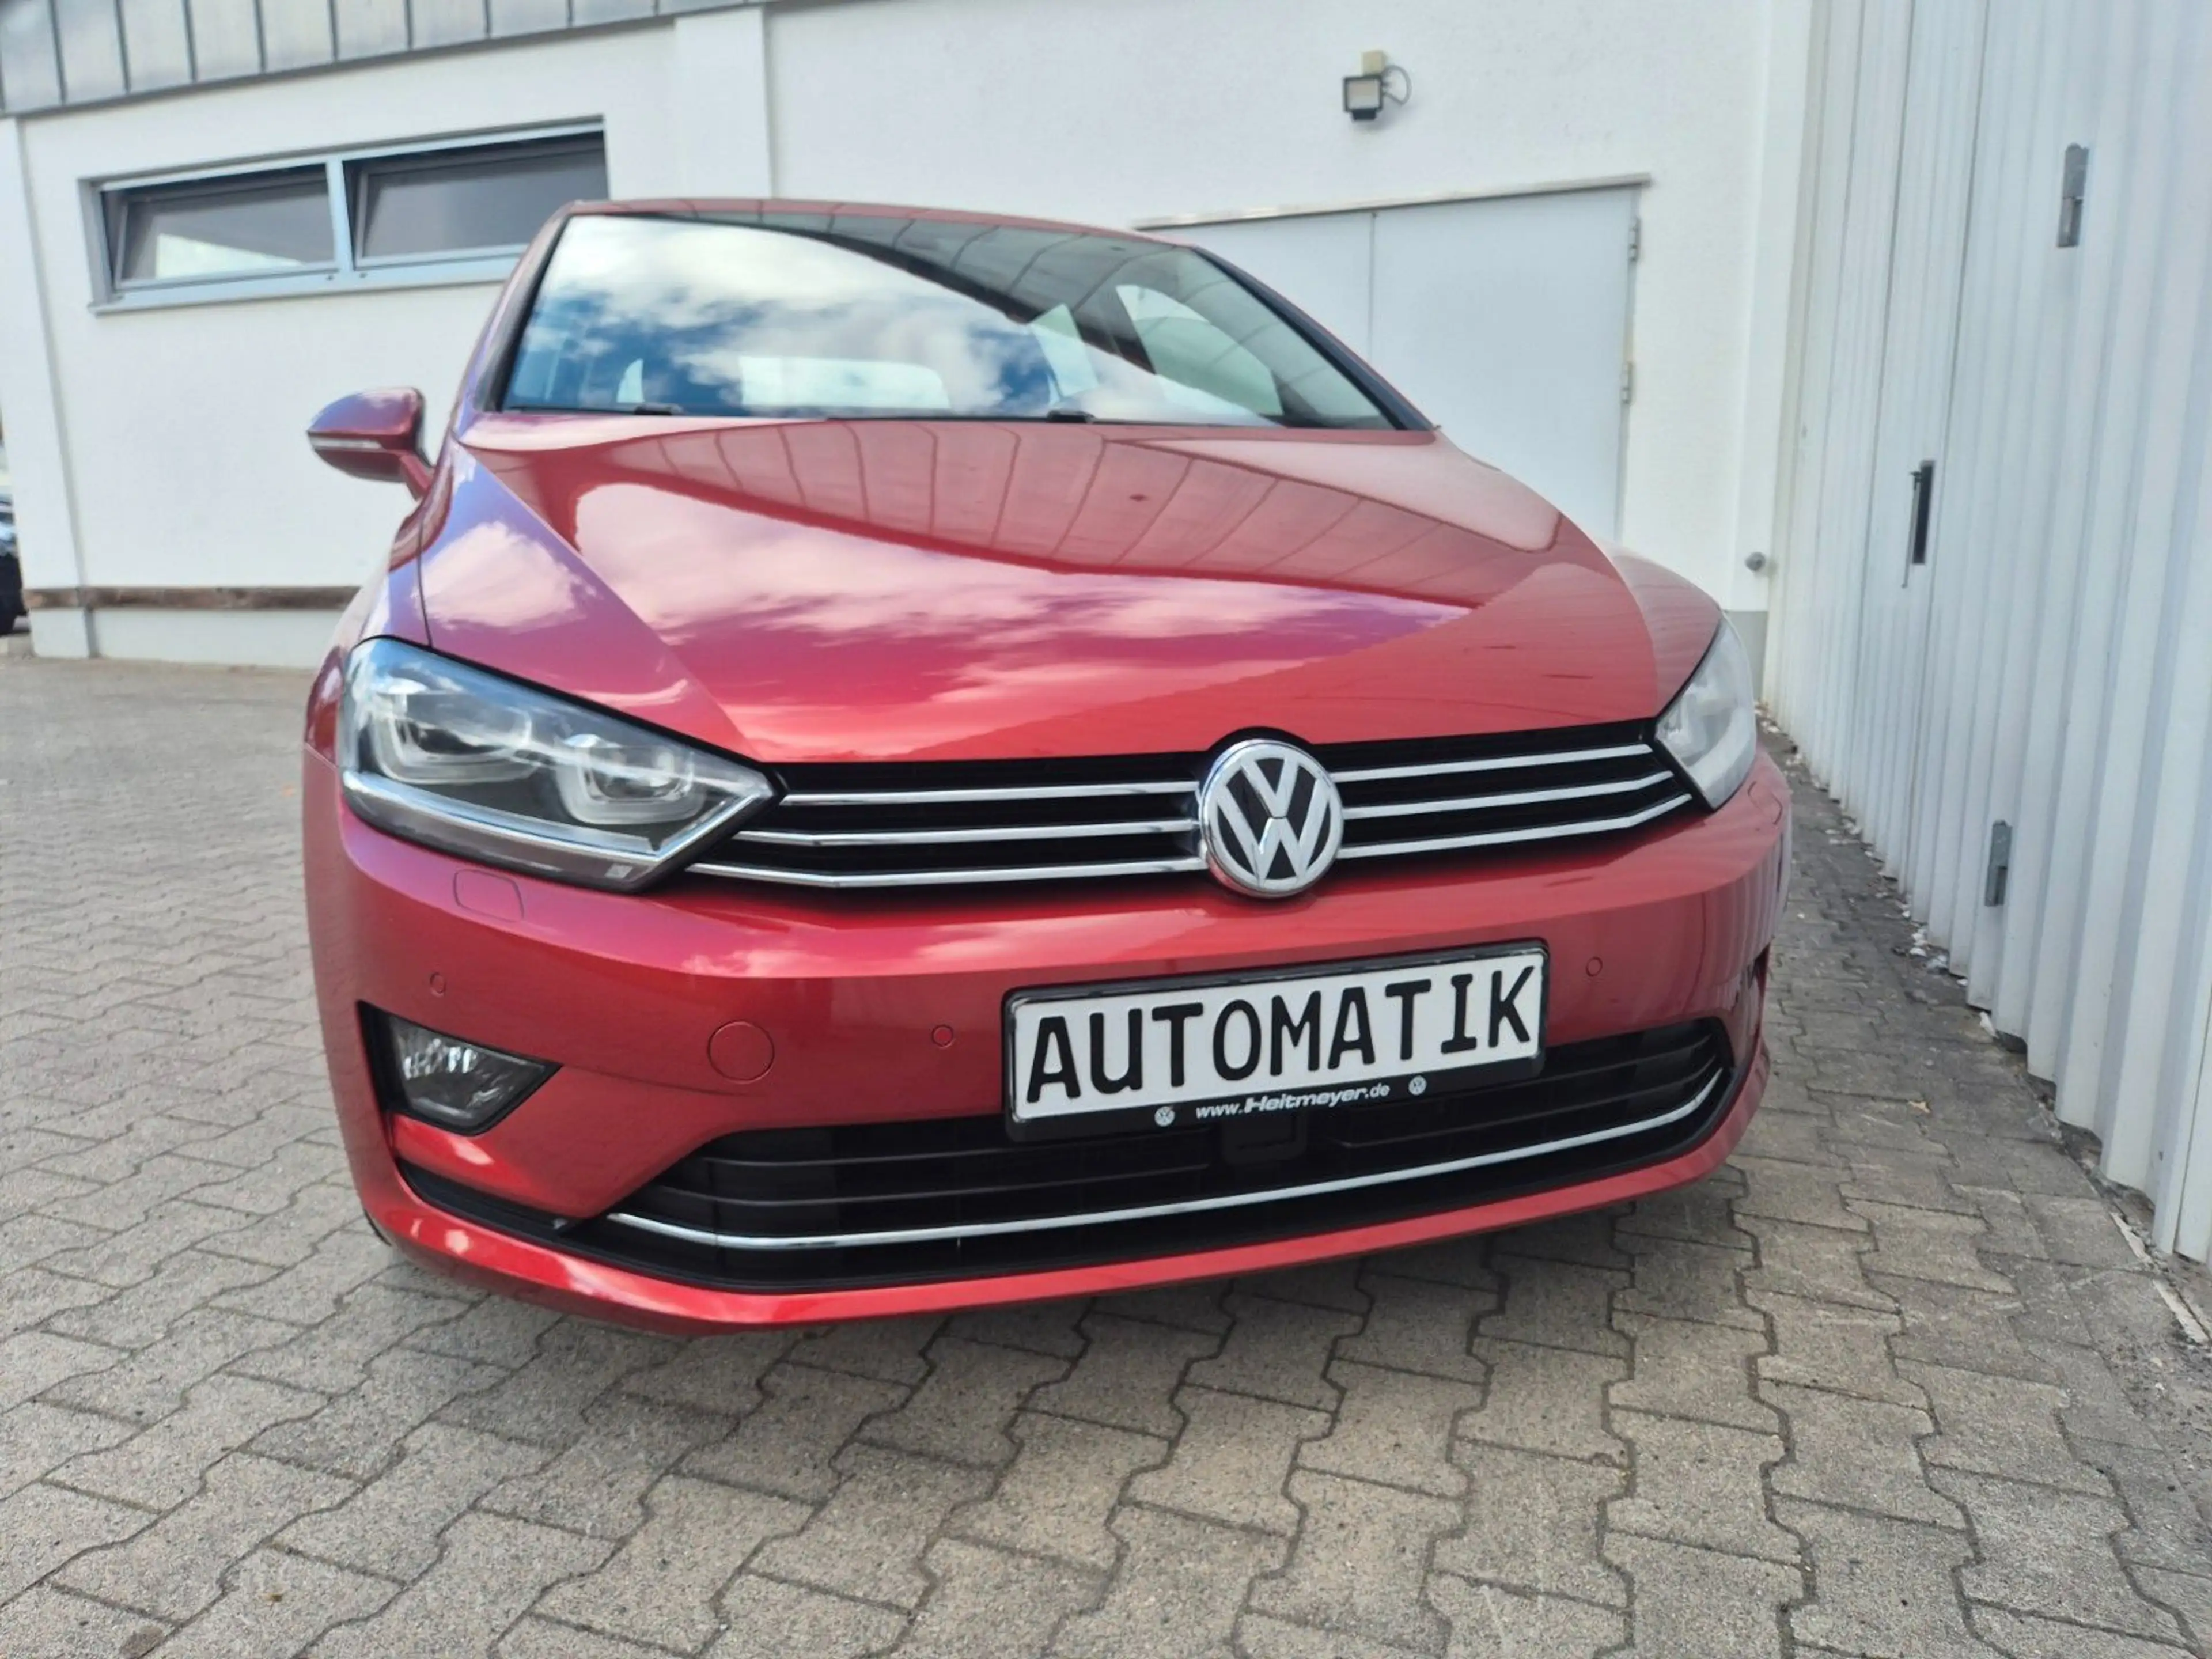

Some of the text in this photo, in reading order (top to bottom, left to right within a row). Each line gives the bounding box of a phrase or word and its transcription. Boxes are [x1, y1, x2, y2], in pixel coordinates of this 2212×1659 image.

[1207, 745, 1336, 892] VW
[1026, 965, 1535, 1103] AUTOMATIK
[1196, 1082, 1390, 1119] www.Heitmeyer.de
